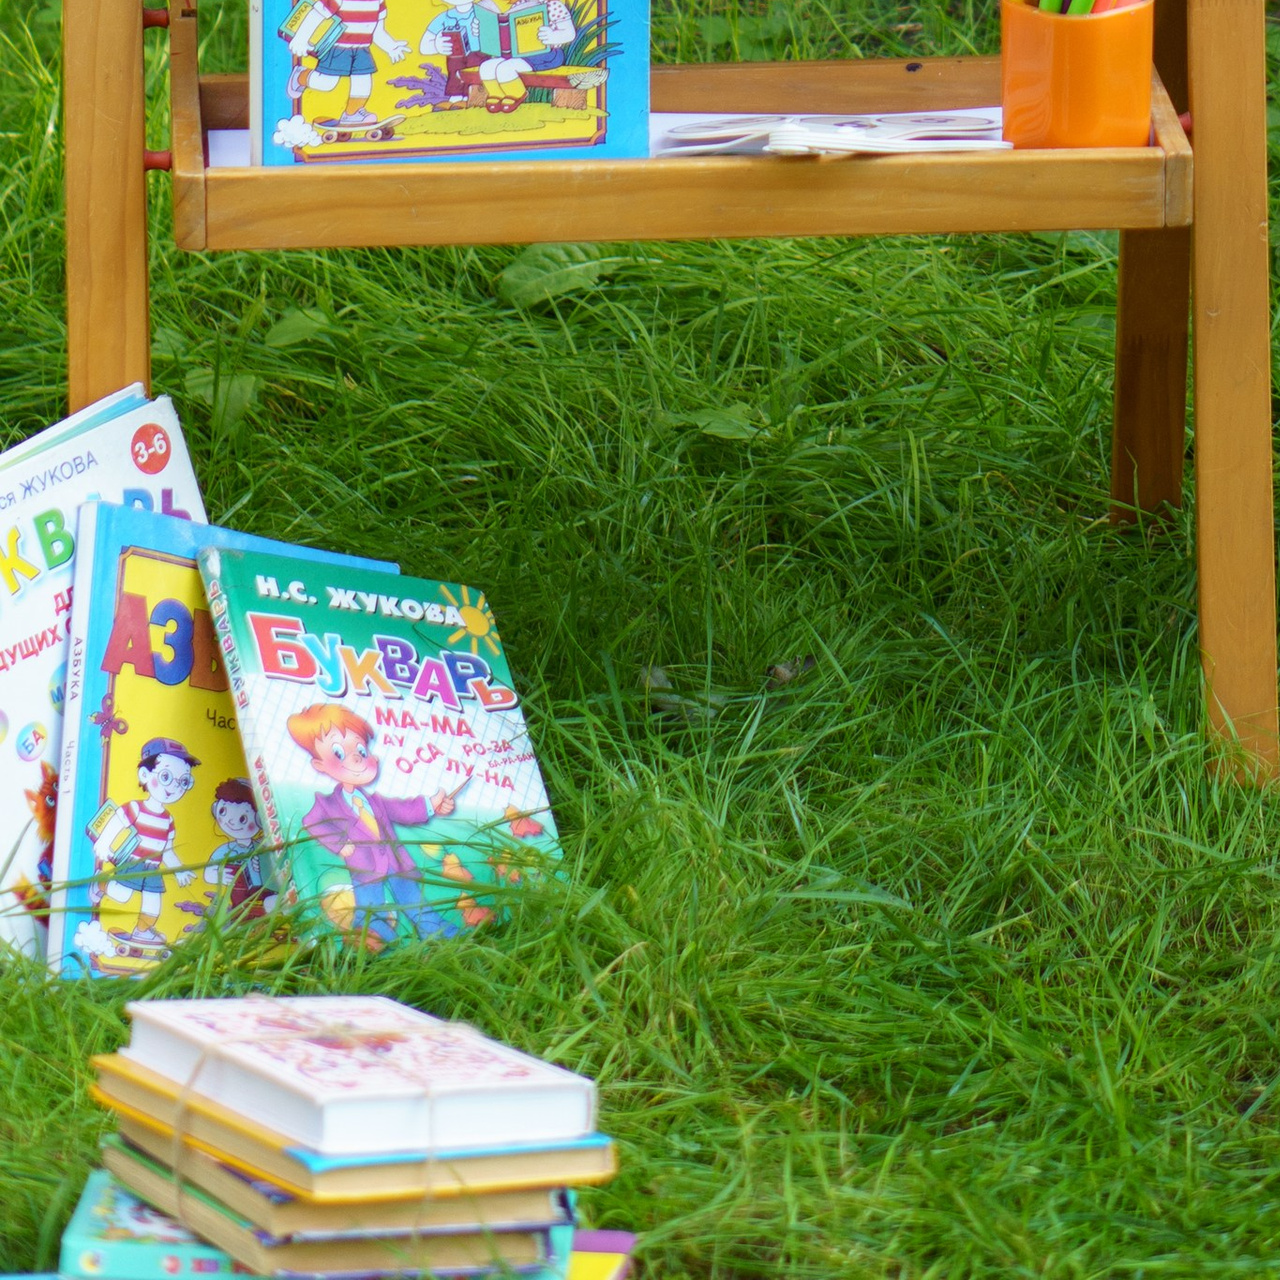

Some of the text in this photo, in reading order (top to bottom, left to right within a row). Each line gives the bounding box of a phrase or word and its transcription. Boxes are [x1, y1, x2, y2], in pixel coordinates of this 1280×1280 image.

[134, 432, 167, 464] 3-6
[19, 450, 99, 501] ЖУКОВА
[256, 575, 466, 627] Н.С. ЖУКОВА
[70, 637, 83, 701] АЗБУКА
[246, 611, 518, 712] БУКВАРЬ
[375, 706, 476, 738] МА-МА
[383, 733, 405, 747] АУ
[395, 742, 445, 774] О-СА
[446, 758, 515, 791] ЛУ-НА
